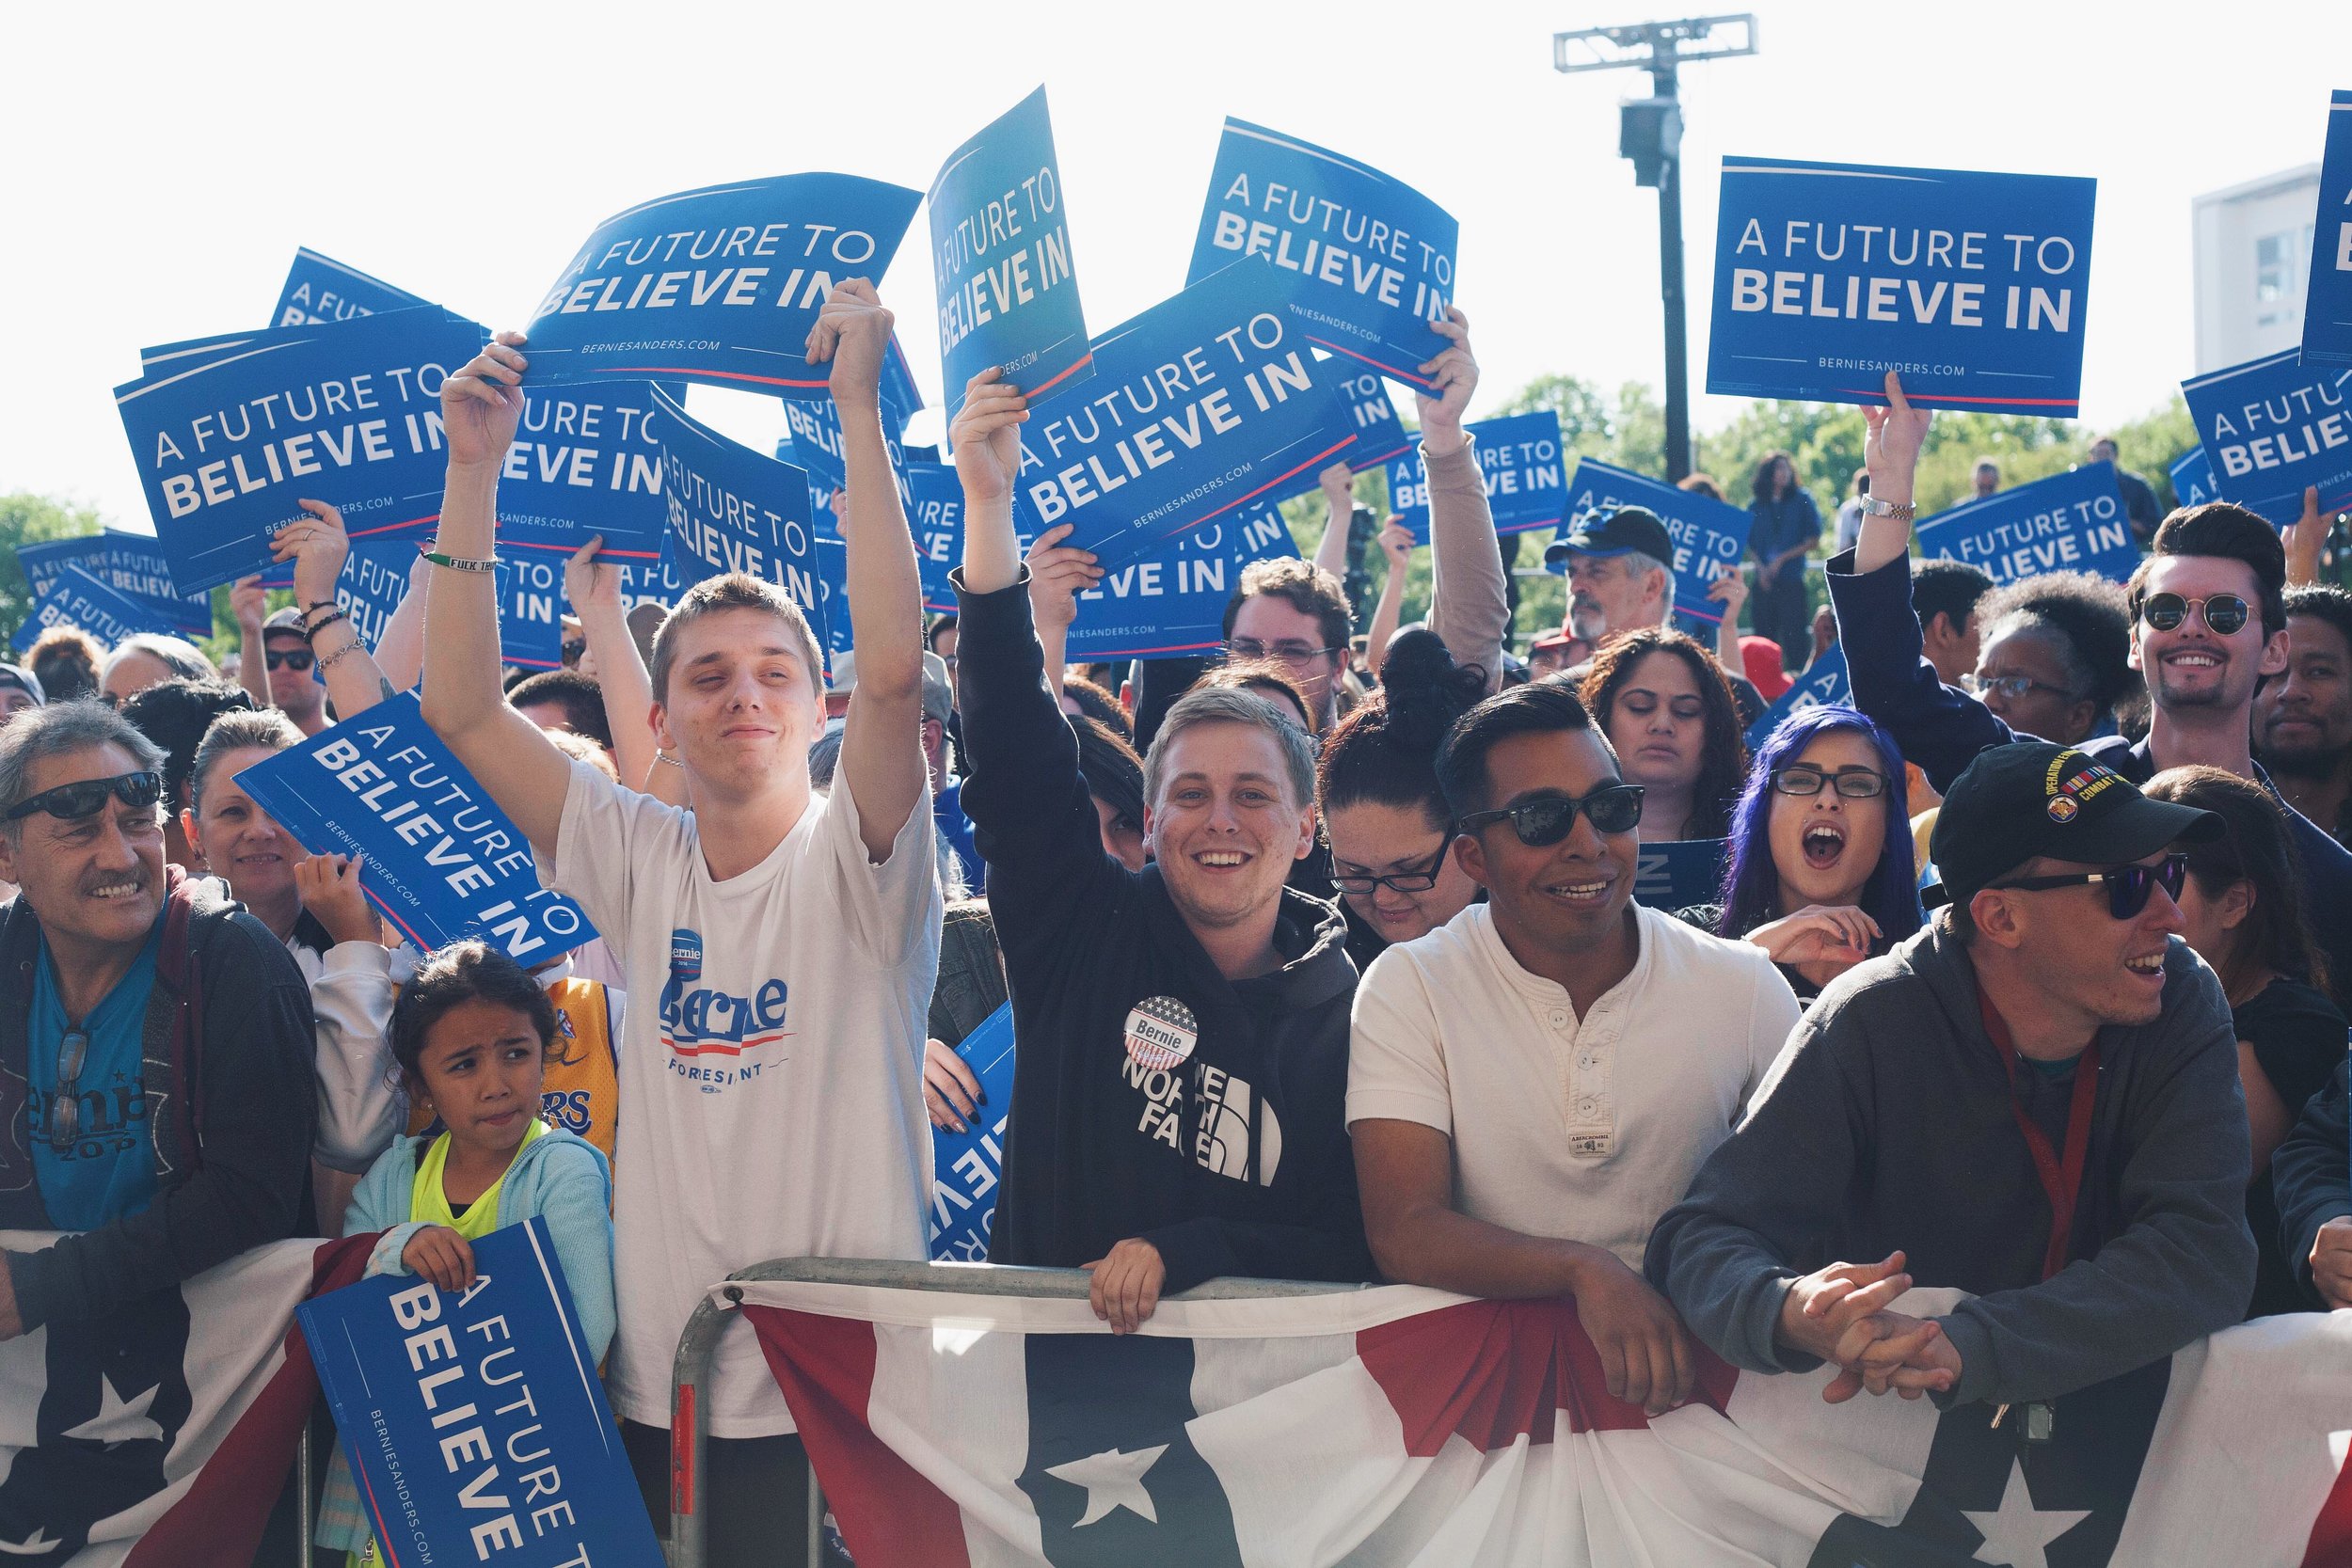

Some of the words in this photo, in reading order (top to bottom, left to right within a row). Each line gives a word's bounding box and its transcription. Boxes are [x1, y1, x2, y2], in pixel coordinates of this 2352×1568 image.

[944, 190, 1023, 276] FUTURE
[1022, 166, 1056, 222] TO
[1224, 172, 1250, 206] A
[1263, 182, 1410, 262] FUTURE
[1418, 241, 1452, 287] TO
[596, 224, 789, 270] FUTURE
[804, 224, 876, 264] TO
[1213, 210, 1406, 309] BELIEVE
[1412, 281, 1452, 323] IN
[1736, 218, 1768, 256] A
[1785, 220, 1988, 270] FUTURE
[2003, 233, 2075, 276] TO
[292, 281, 310, 308] A
[539, 267, 771, 318] BELIEVE
[941, 248, 1034, 358] BELIEVE
[1035, 225, 1071, 292] IN
[1731, 268, 1986, 327] BELIEVE
[2005, 285, 2072, 333] IN
[580, 339, 721, 355] BERNIESANDERS.COM
[1289, 303, 1382, 344] RNIESANDERS.COM
[1340, 373, 1378, 401] TO
[1818, 356, 1965, 377] BERNIESANDERS.COM
[156, 431, 185, 468] A
[191, 373, 379, 452] FUTURE
[385, 362, 448, 408] TO
[523, 397, 604, 439] URE
[1020, 440, 1045, 477] A
[1042, 346, 1216, 459] FUTURE
[1215, 312, 1283, 363] TO
[1354, 397, 1391, 428] IN
[2216, 413, 2239, 441] A
[2243, 382, 2344, 433] FUTU
[1028, 387, 1243, 524] BELIEVE
[1244, 351, 1313, 413] IN
[1396, 462, 1411, 483] A
[1517, 439, 1556, 463] TO
[2219, 409, 2352, 478] BELIE
[161, 419, 395, 519] BELIEVE
[610, 451, 663, 496] IN
[1525, 464, 1561, 491] IN
[499, 512, 575, 531] SANDERS.COM
[662, 443, 673, 480] A
[672, 453, 760, 539] FUTURE
[764, 509, 807, 558] TO
[1133, 461, 1254, 531] BERNIESANDERS.COM
[666, 484, 764, 576] BELIEVE
[774, 557, 816, 611] IN
[1243, 511, 1283, 553] IN
[1577, 489, 1595, 510] A
[1705, 529, 1739, 559] TO
[1959, 507, 2073, 562] FUTURE
[2074, 495, 2117, 524] TO
[342, 550, 356, 583] A
[451, 559, 478, 571] FUCK
[513, 559, 553, 590] TO
[1178, 558, 1225, 594] IN
[1981, 534, 2082, 584] LIEVE
[2086, 520, 2128, 555] IN
[54, 587, 71, 607] A
[516, 591, 553, 625] IN
[1067, 625, 1156, 639] NIESANDERS.COM
[1813, 671, 1839, 697] A
[2078, 776, 2116, 801] COMBAT
[311, 736, 497, 900] BELIEVE
[477, 899, 547, 958] IN
[358, 723, 396, 750] A
[387, 745, 534, 879] FUTURE
[524, 887, 580, 936] TO
[325, 819, 421, 908] BERNIESANDERS.COM
[672, 946, 701, 960] ernie
[1136, 1019, 1183, 1050] Bernie
[1137, 1101, 1211, 1169] FAE
[457, 1274, 493, 1308] A
[388, 1281, 525, 1561] BELIEVE
[466, 1314, 577, 1538] FUTURE
[370, 1409, 434, 1566] BERNIESANDERS.COM
